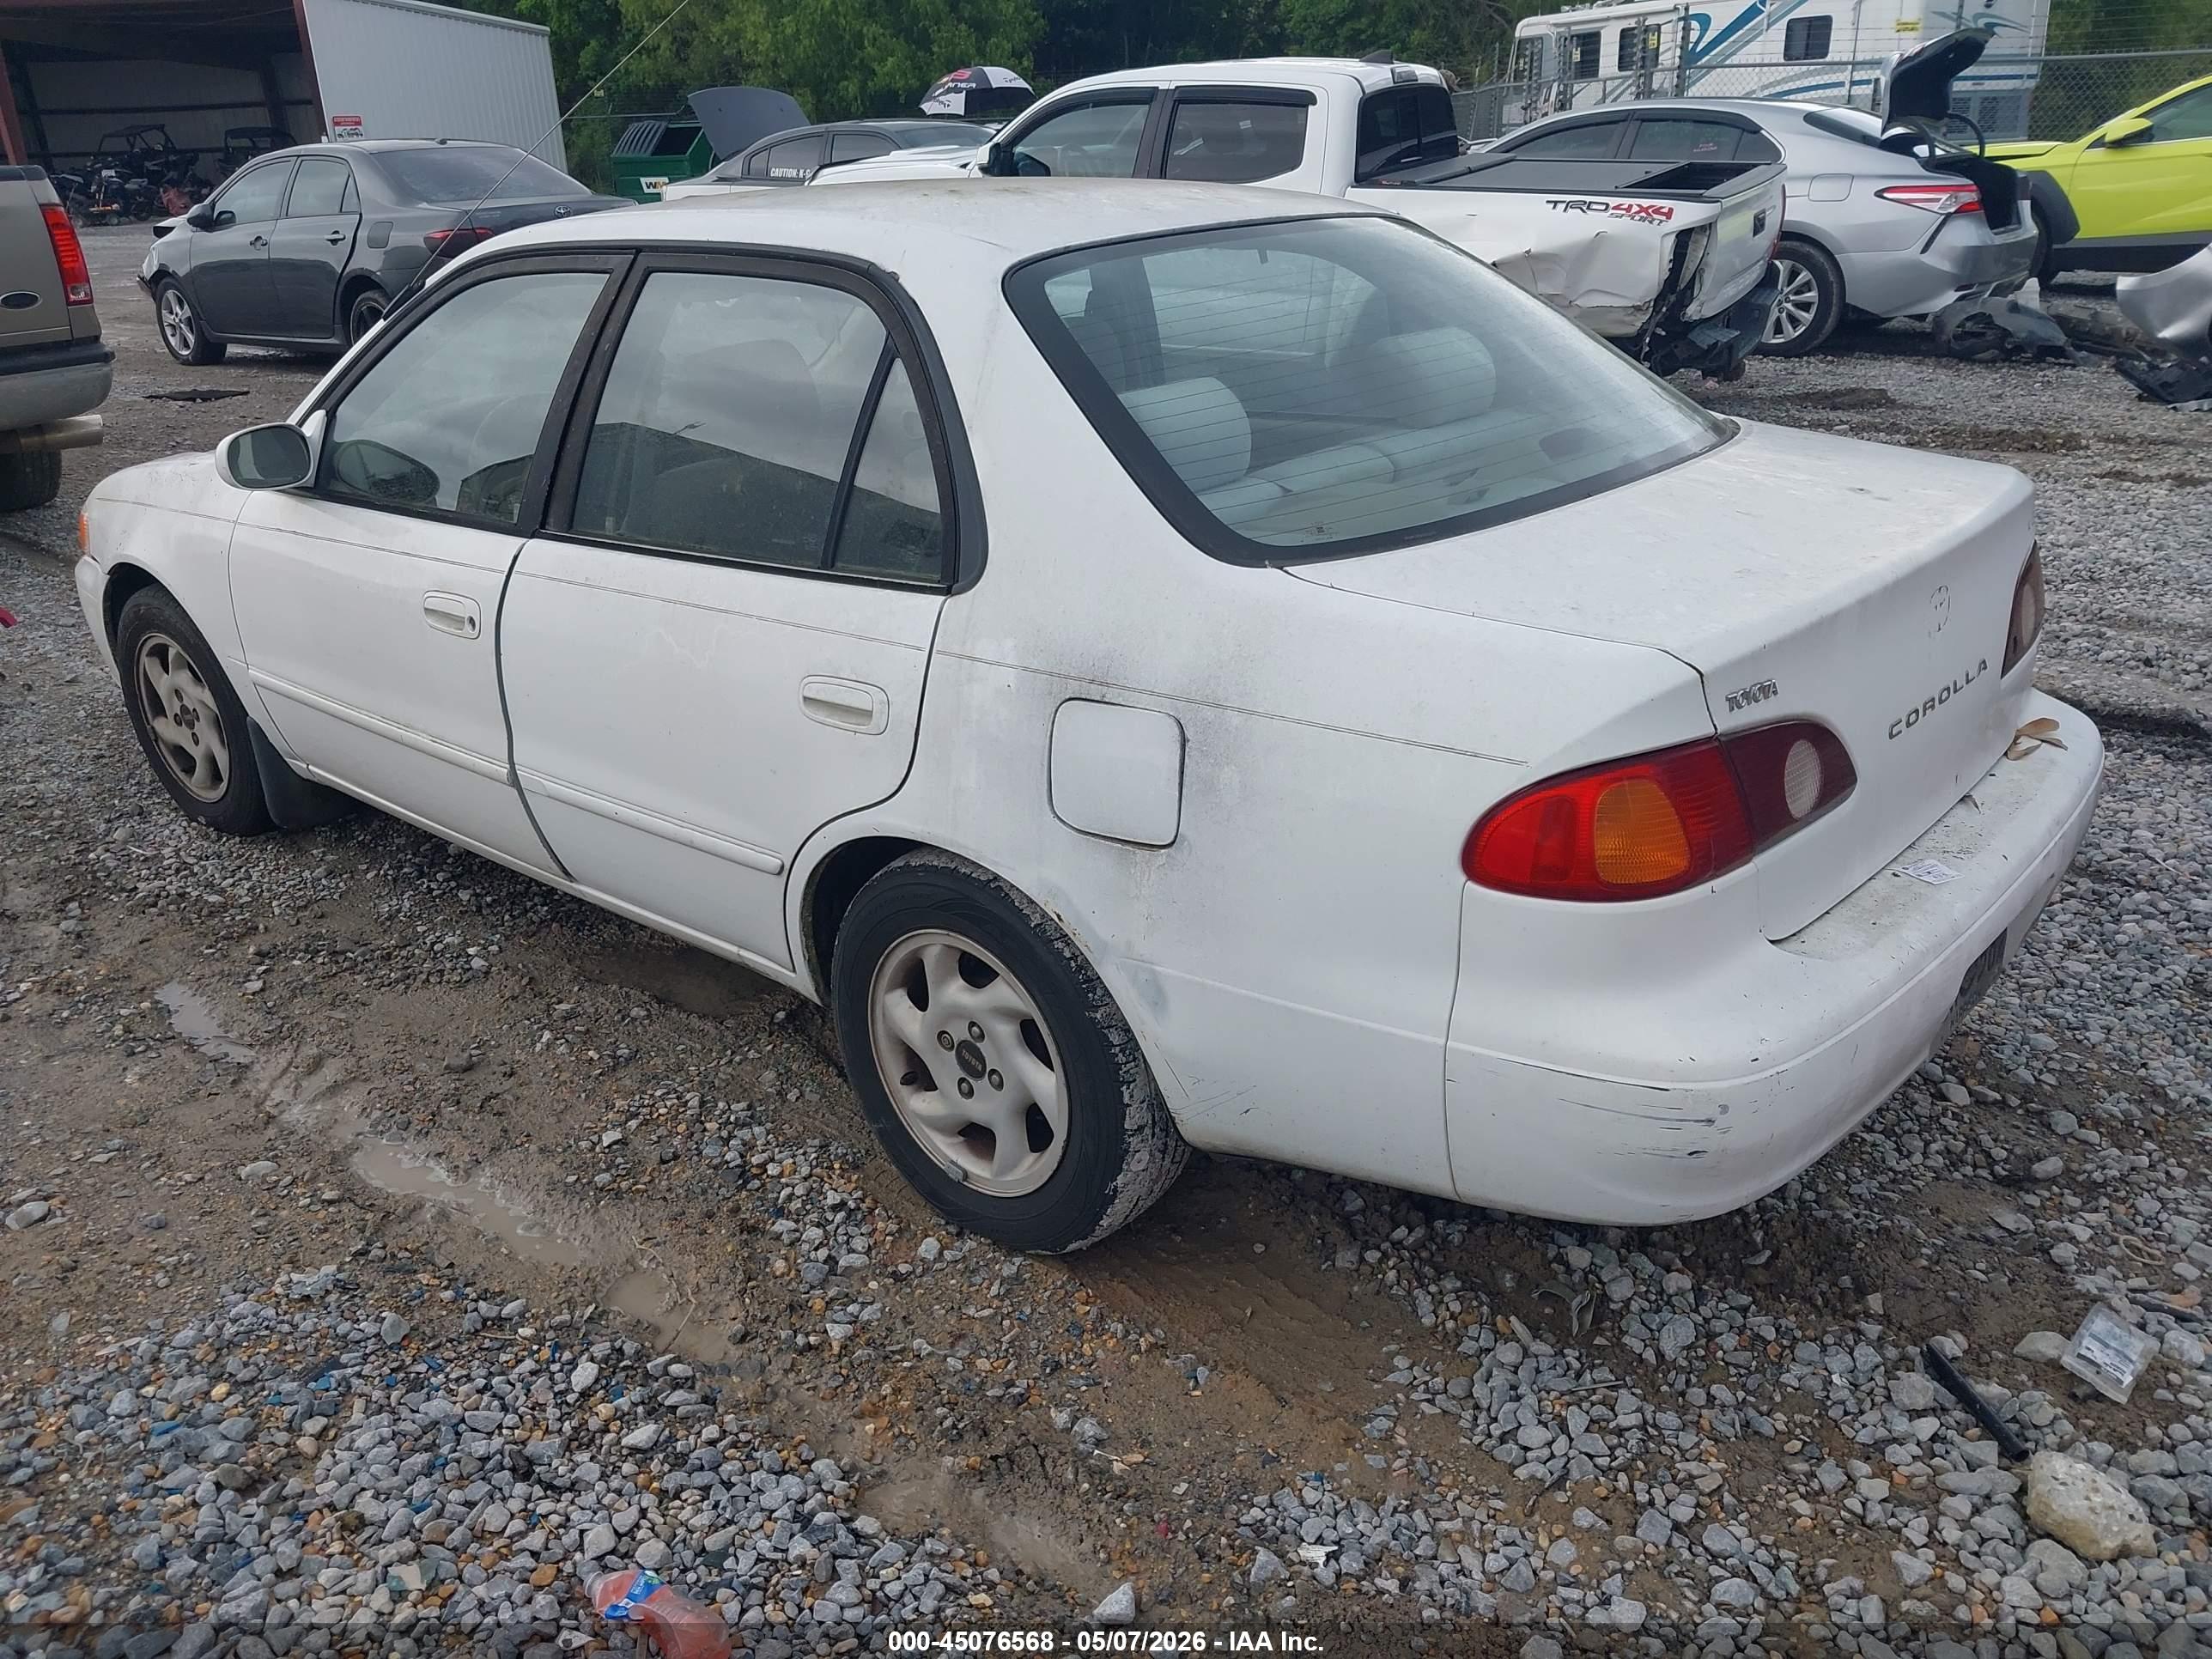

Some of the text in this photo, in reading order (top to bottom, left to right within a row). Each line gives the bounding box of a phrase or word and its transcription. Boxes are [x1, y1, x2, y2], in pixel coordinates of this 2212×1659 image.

[1607, 212, 1668, 226] SPORT
[1725, 679, 1778, 712] TOYOTA
[1889, 658, 1988, 739] COROLLA
